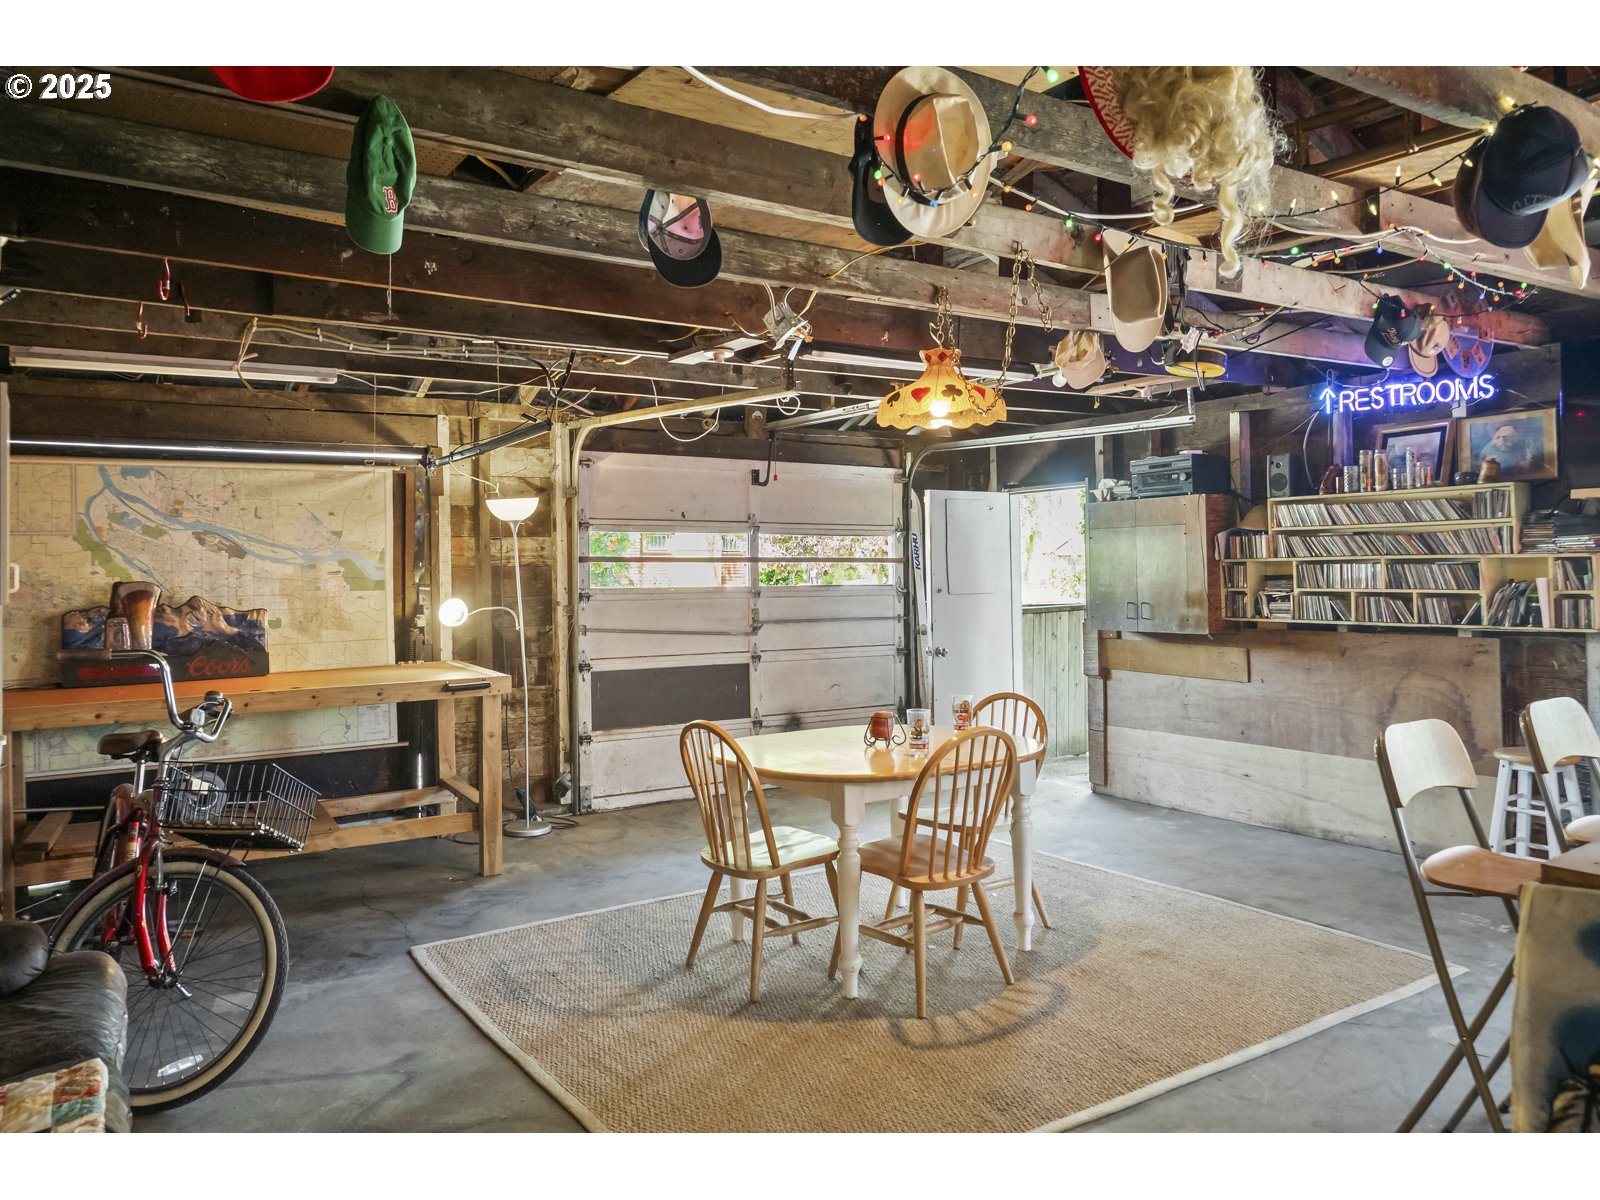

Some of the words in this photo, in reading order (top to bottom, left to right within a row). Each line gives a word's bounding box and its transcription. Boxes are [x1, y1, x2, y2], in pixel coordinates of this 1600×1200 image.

[383, 186, 398, 212] B
[1339, 374, 1495, 413] RESTROOMS
[912, 533, 921, 570] KARHU
[188, 655, 250, 677] Coors
